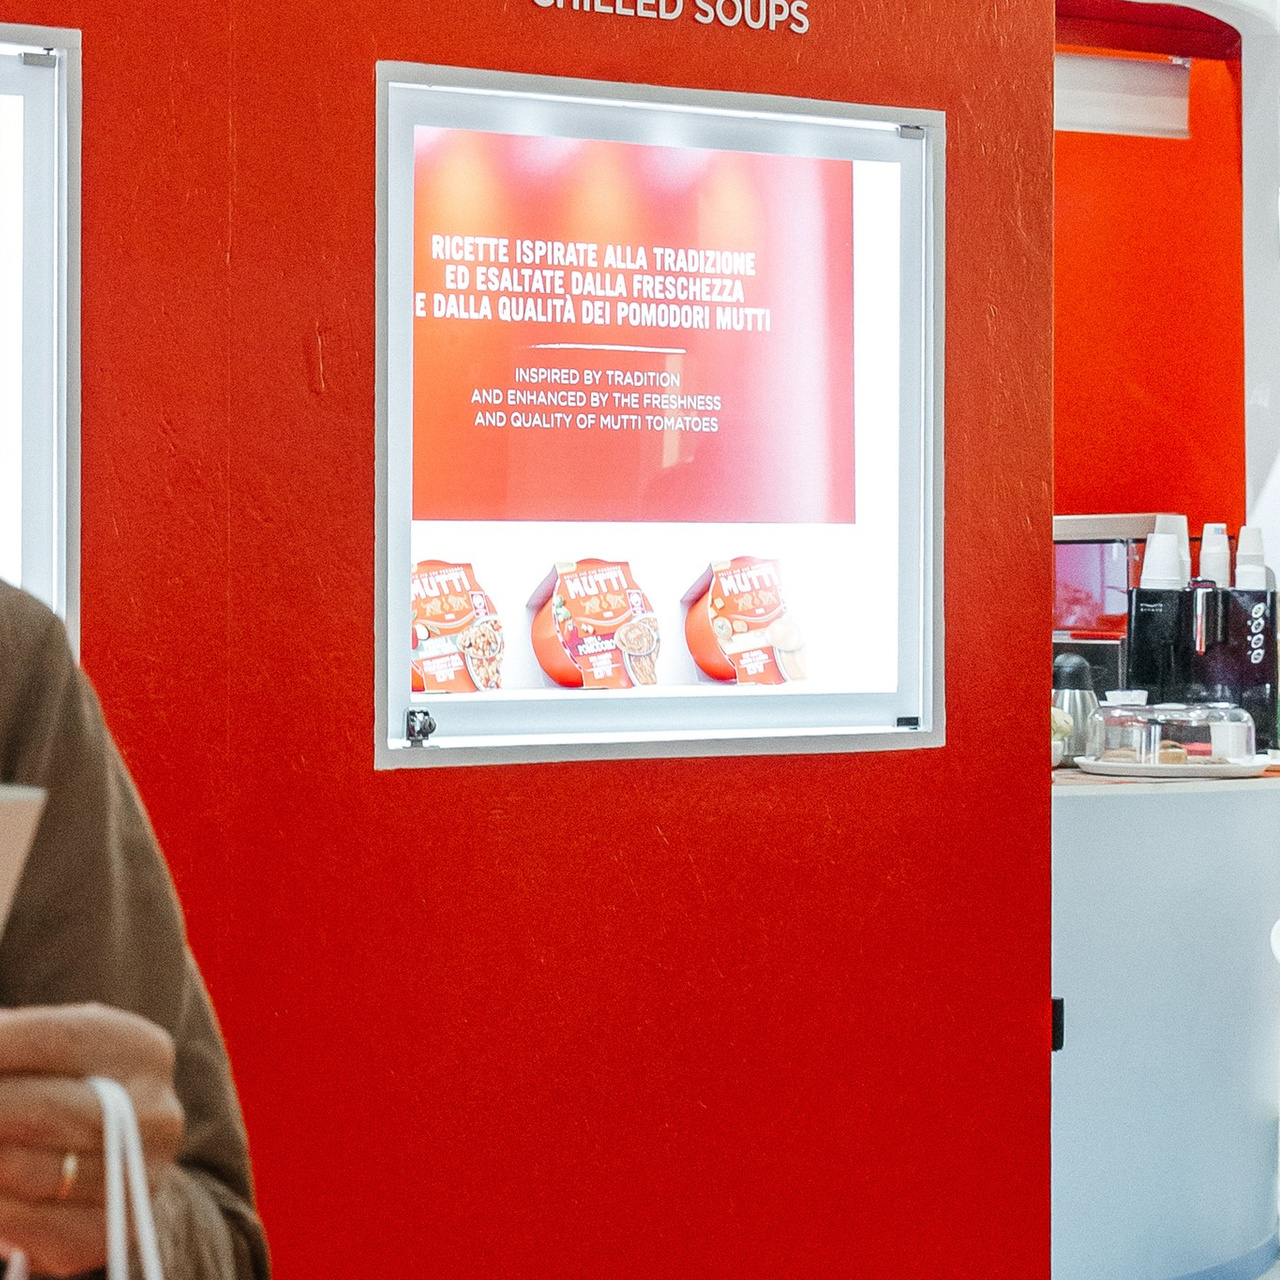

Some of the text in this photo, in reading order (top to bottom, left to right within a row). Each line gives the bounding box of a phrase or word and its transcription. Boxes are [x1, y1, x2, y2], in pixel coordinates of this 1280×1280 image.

[431, 234, 757, 277] RICETTE ISPIRATE ALLA TRADIZIONE
[444, 264, 746, 304] ED ESALTATE DALLA FRESCHEZZA
[414, 291, 772, 333] E DALLA QUALITÀ DEI POMODORI MUTTI
[514, 366, 681, 388] INSPIRED BY TRADITION
[470, 387, 722, 412] AND ENHANCED BY THE FRESHNESS
[473, 410, 720, 433] AND QUALITY OF MUTTI TOMATOES
[410, 570, 472, 601] MUTTI
[564, 569, 629, 600] MUTTI
[718, 566, 780, 598] MUTTI
